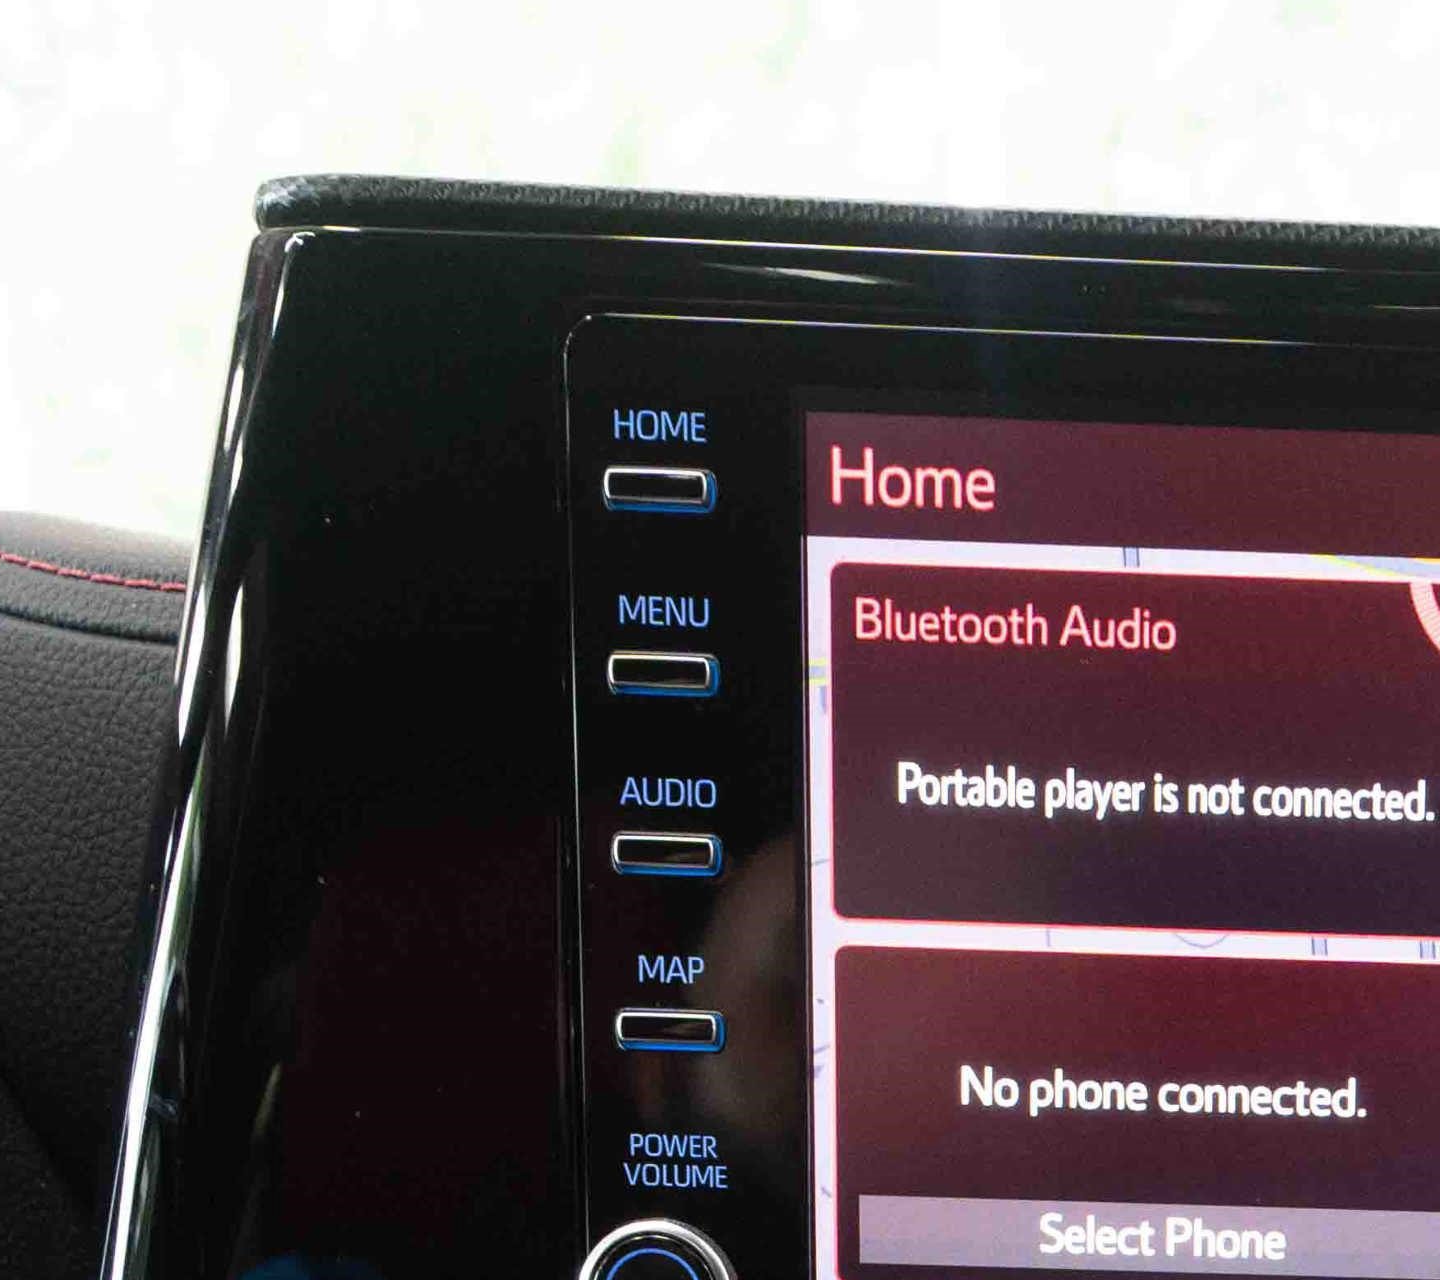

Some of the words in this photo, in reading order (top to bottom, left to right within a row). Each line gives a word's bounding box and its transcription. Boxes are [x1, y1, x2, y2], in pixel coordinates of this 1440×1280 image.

[613, 409, 707, 443] HOME
[830, 444, 996, 512] Home
[618, 594, 710, 628] MENU
[855, 596, 1049, 646] Bluetooth
[1059, 604, 1177, 651] Audio
[619, 776, 717, 809] AUDIO
[897, 760, 1036, 809] Portable
[1044, 767, 1146, 821] player
[1153, 772, 1180, 814] is
[1187, 777, 1246, 816] not
[1252, 778, 1436, 822] connected.
[637, 954, 705, 984] MAP
[959, 1064, 1020, 1108] No
[1029, 1067, 1149, 1117] phone
[1157, 1076, 1367, 1119] connected.
[629, 1133, 718, 1159] POWER
[623, 1162, 728, 1189] VOLUME
[1039, 1212, 1156, 1257] Select
[1165, 1216, 1287, 1260] Phone
